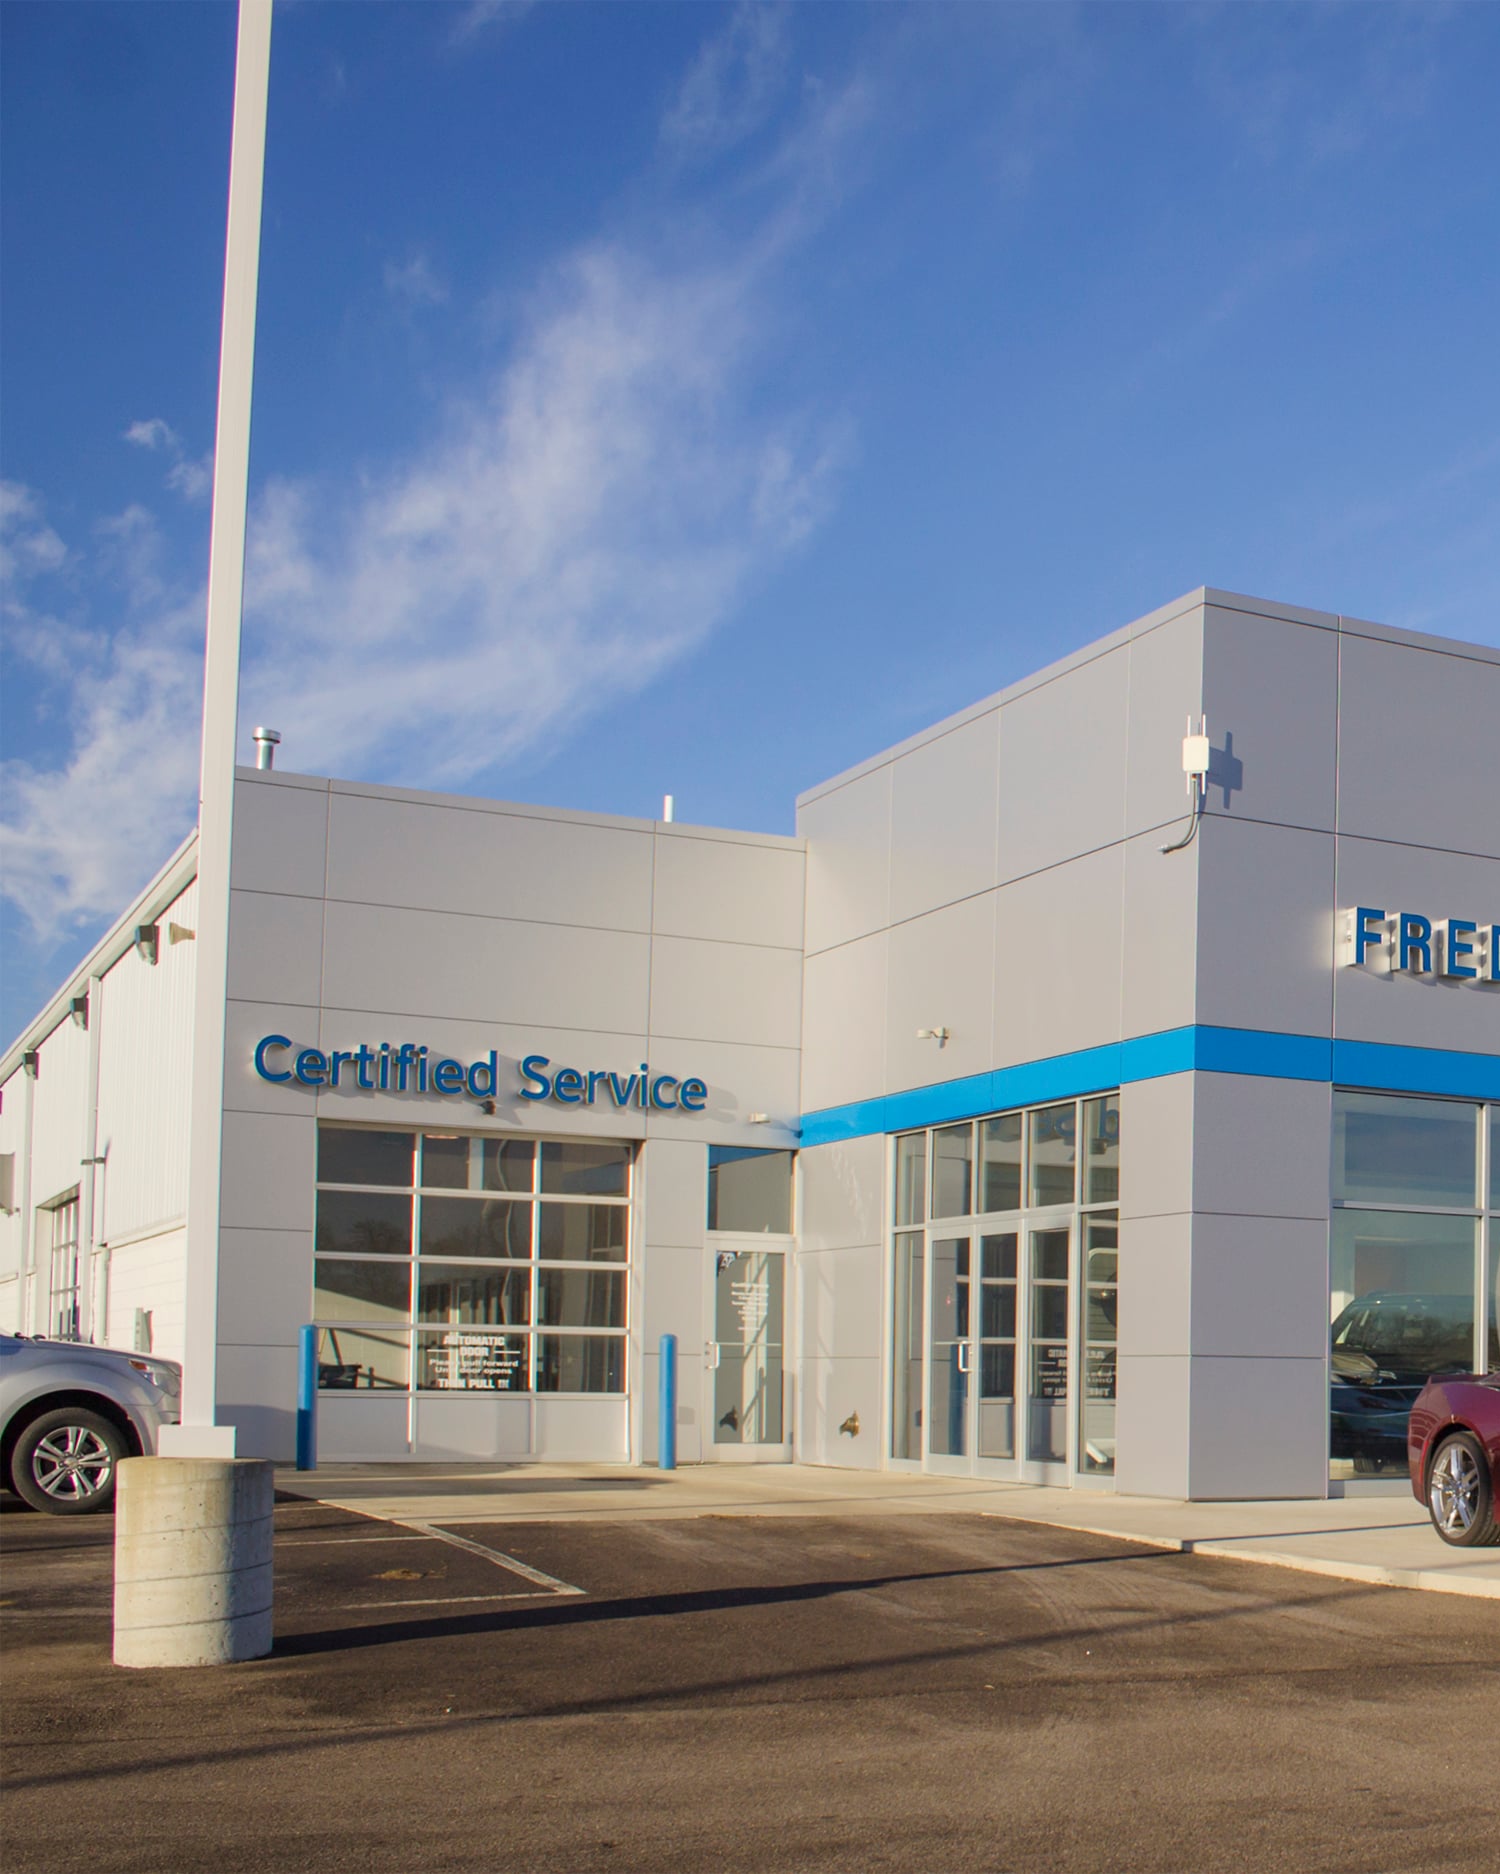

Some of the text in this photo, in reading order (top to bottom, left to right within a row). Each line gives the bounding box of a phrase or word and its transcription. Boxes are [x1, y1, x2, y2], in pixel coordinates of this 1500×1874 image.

[254, 1034, 708, 1112] Certified Service
[443, 1335, 505, 1346] AUTOMATIC
[460, 1346, 489, 1356] DOOR
[437, 1378, 466, 1388] THN
[468, 1379, 495, 1389] PULL
